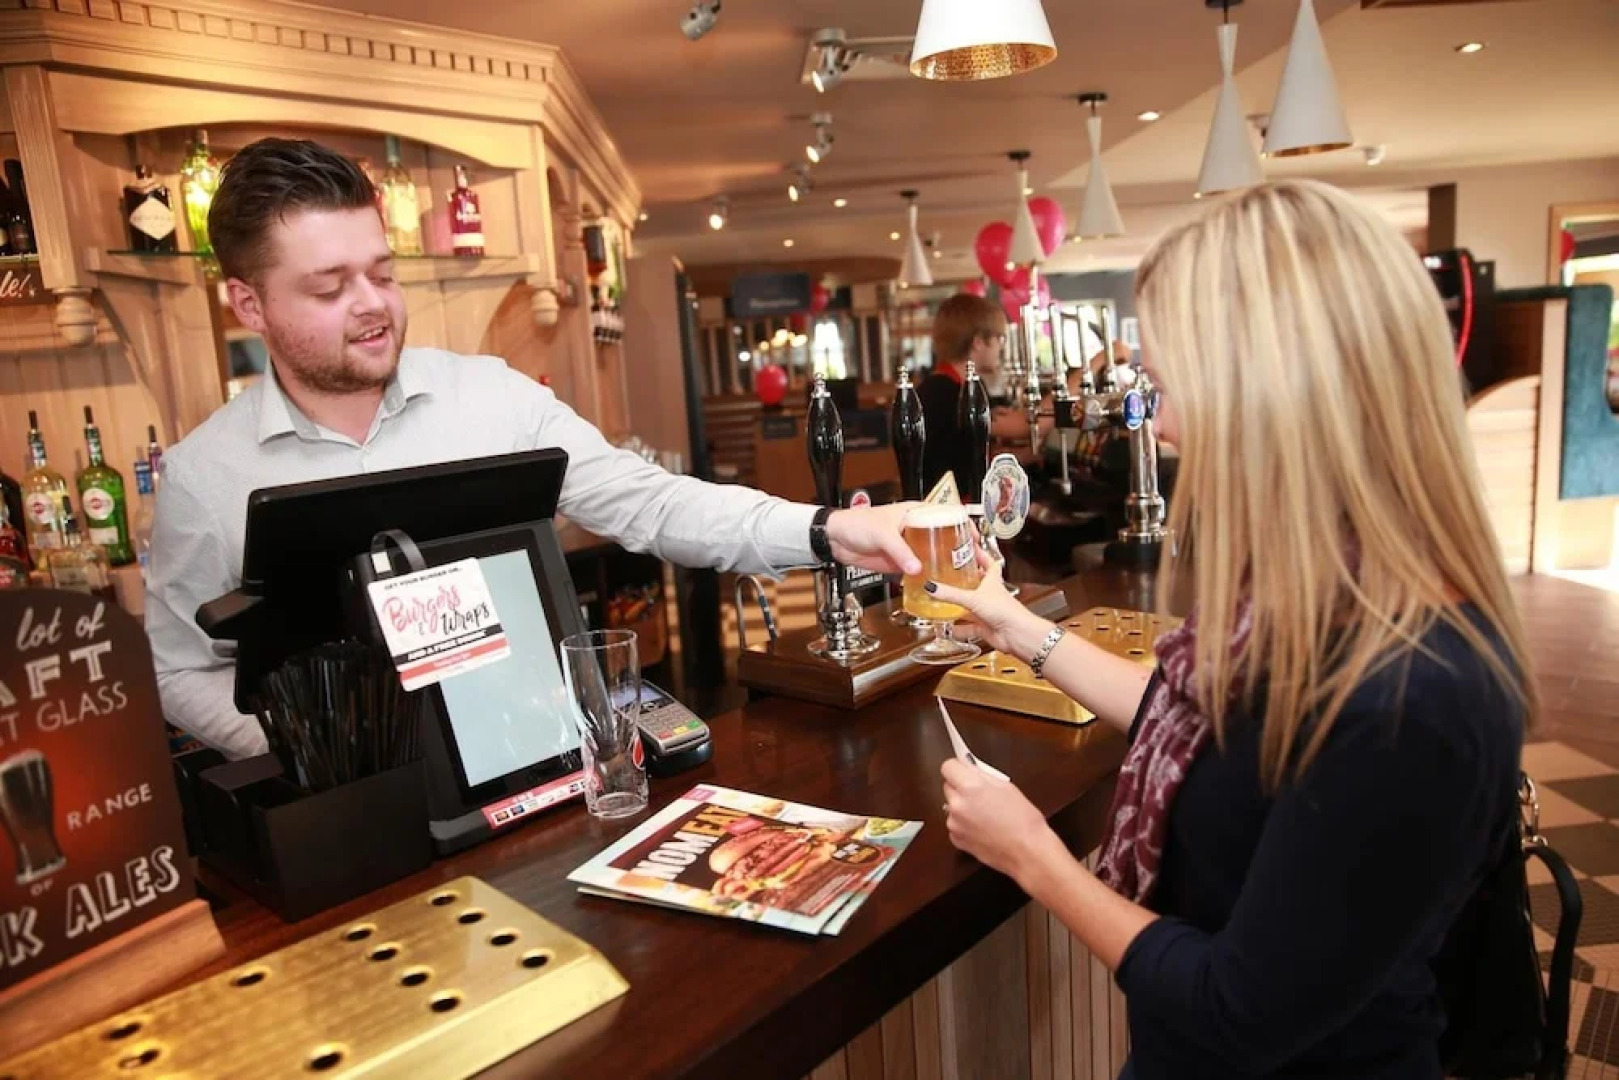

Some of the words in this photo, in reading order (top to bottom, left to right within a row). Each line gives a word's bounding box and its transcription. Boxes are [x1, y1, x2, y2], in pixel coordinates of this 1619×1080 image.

[16, 606, 62, 651] lot
[75, 601, 105, 639] of
[382, 585, 461, 634] Burgers
[440, 601, 490, 636] Wraps
[36, 681, 128, 732] GLASS
[66, 783, 153, 830] RANGE
[0, 907, 44, 969] K
[65, 845, 181, 938] ALES
